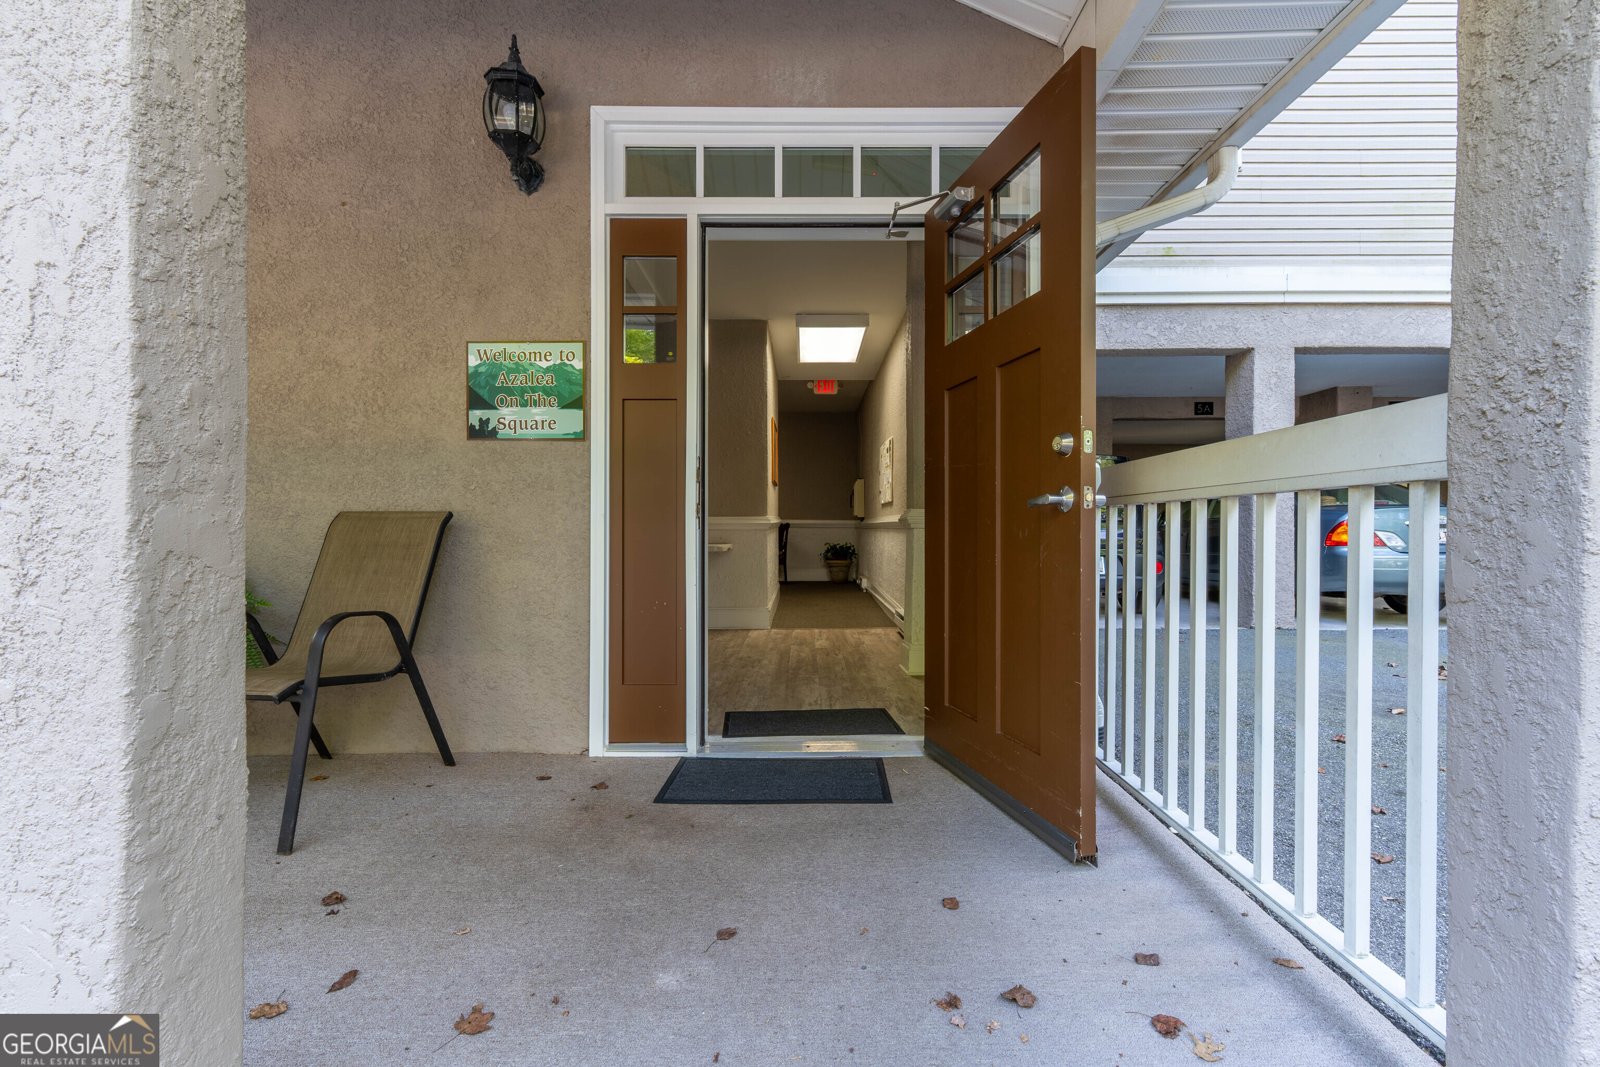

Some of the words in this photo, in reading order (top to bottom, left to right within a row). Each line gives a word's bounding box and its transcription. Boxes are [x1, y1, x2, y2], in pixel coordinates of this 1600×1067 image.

[476, 347, 553, 362] Welcome
[559, 349, 576, 362] to
[496, 370, 555, 387] Azalea
[495, 394, 520, 409] On
[525, 393, 558, 409] The
[1197, 404, 1211, 413] 5A
[496, 416, 557, 434] Square
